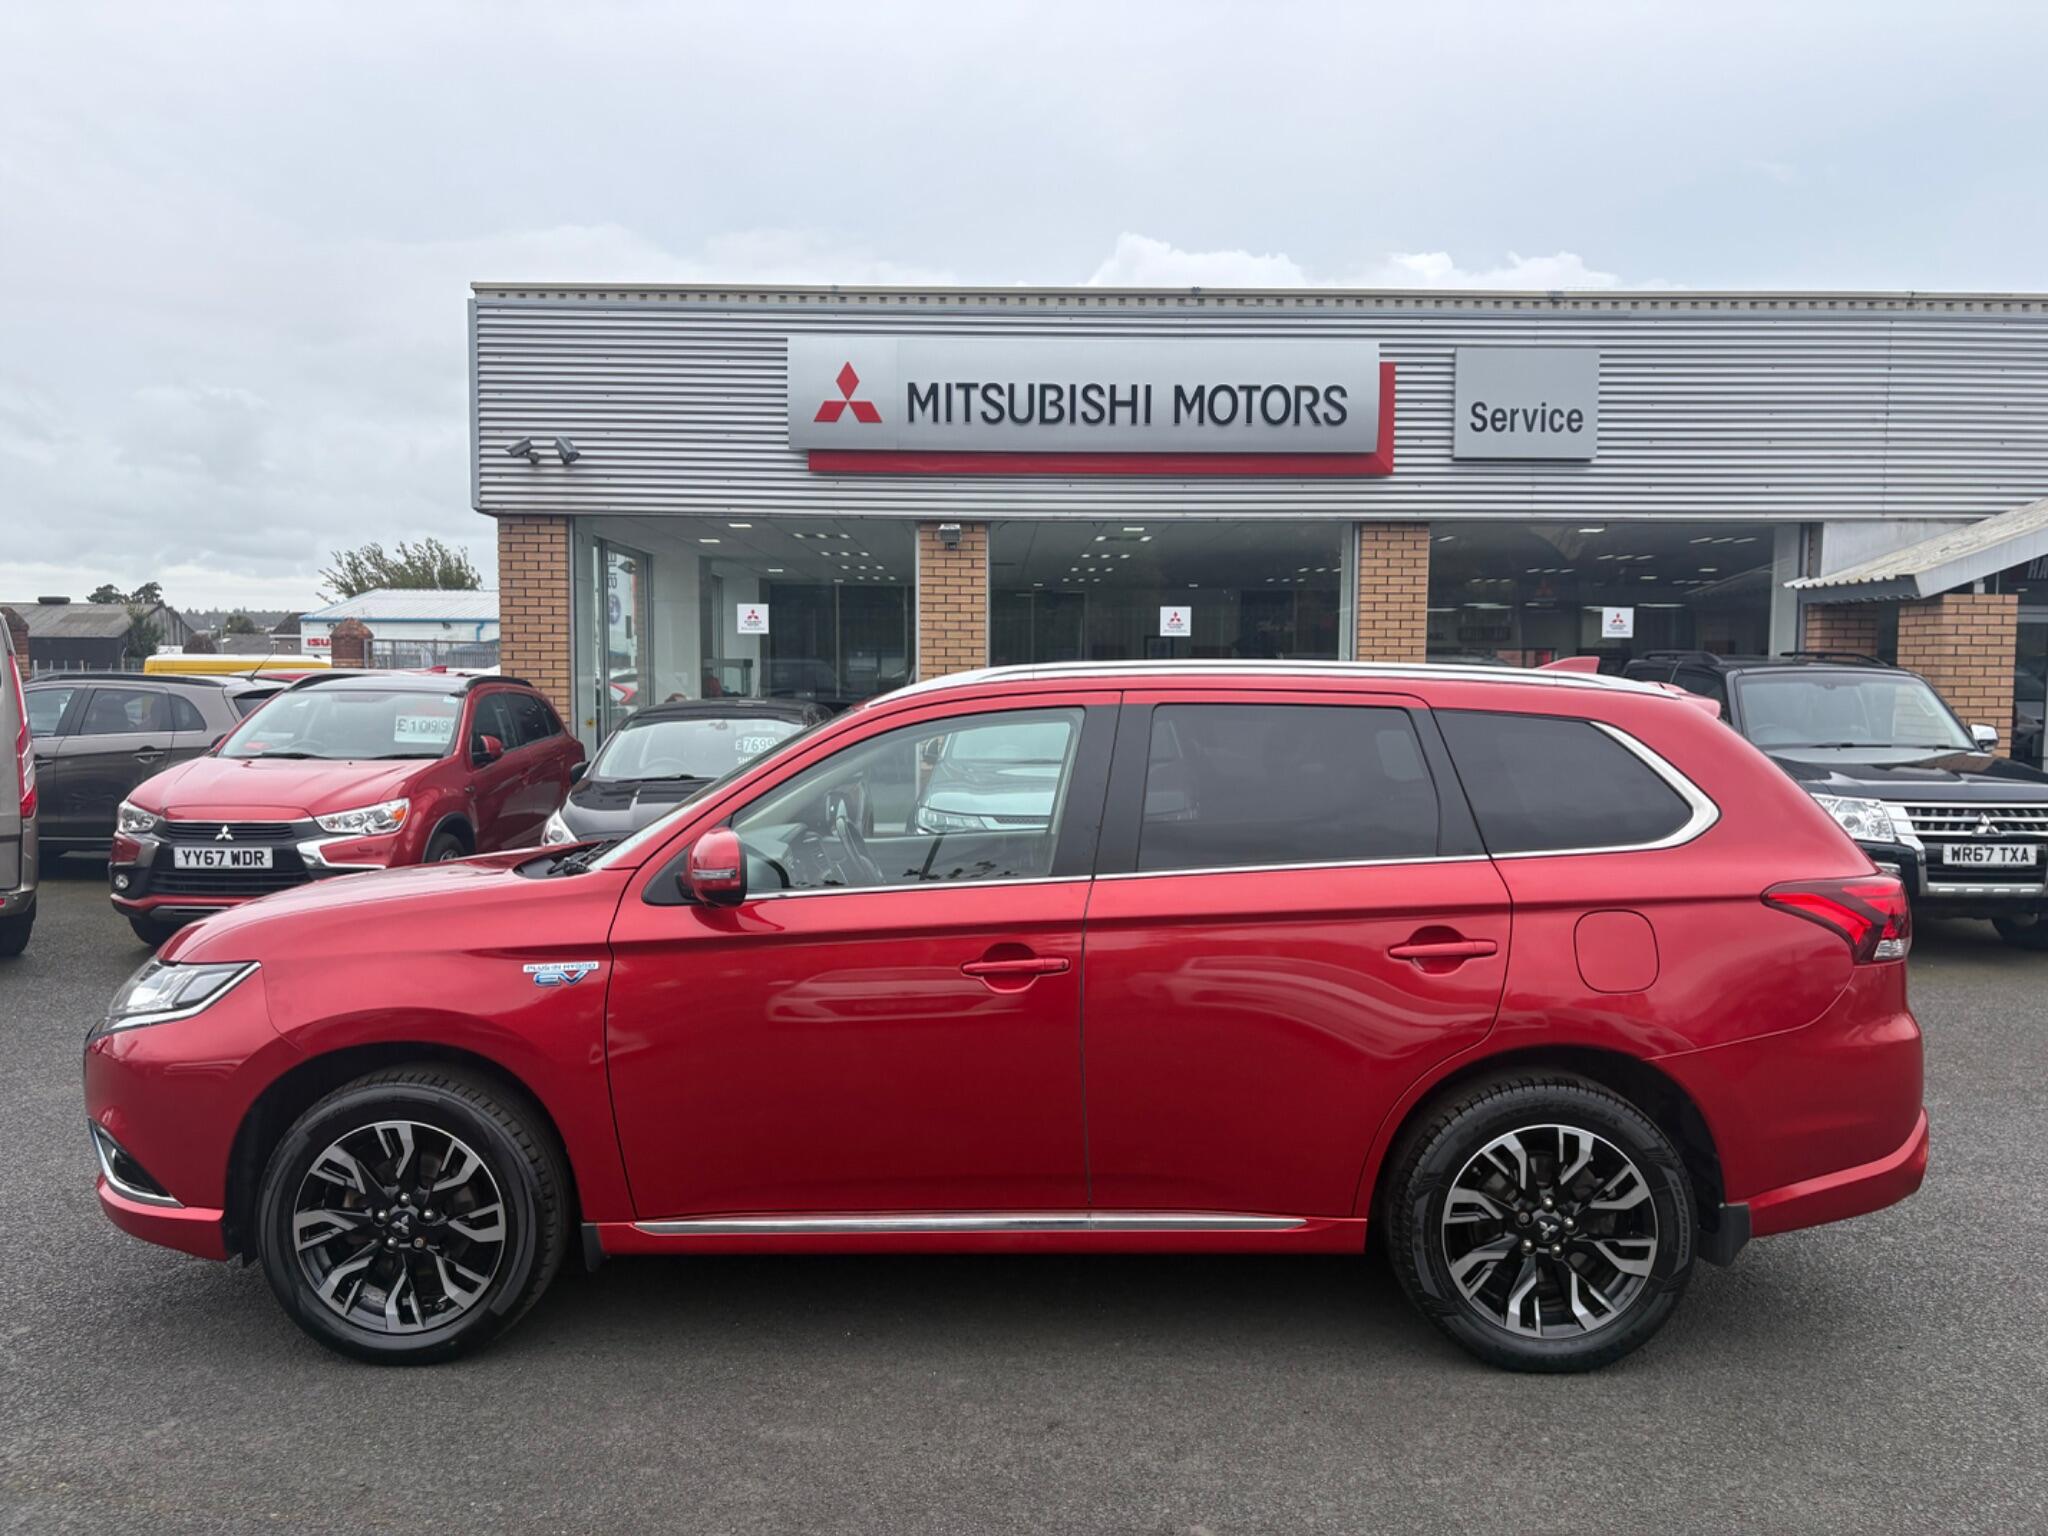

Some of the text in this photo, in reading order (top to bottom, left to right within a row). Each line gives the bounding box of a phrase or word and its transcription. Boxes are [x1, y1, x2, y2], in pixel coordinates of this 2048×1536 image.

[907, 382, 1348, 425] MITSUBISHI MOTORS
[1470, 401, 1584, 433] Service
[182, 850, 264, 866] YY67 WDR
[1951, 847, 2029, 862] WR67 TXA
